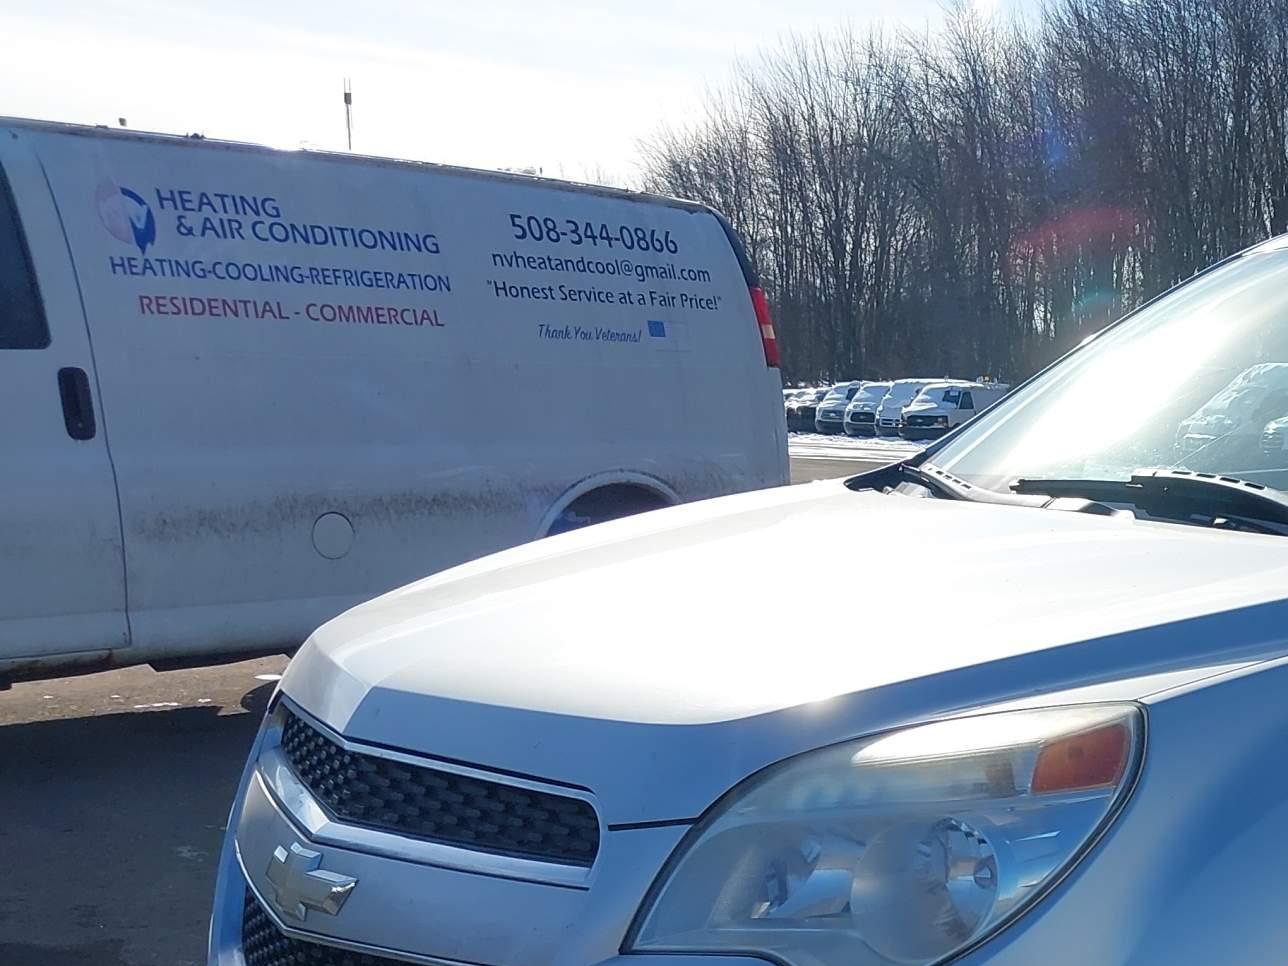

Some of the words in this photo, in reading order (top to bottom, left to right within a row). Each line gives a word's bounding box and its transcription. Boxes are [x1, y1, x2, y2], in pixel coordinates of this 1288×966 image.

[155, 188, 281, 218] HEATING
[176, 215, 196, 237] &
[201, 217, 243, 240] AIR
[251, 220, 441, 254] CONDITIONING
[510, 213, 678, 254] 508-344-0866
[109, 255, 452, 292] HEATING-COOLING-REFRIGERATION
[492, 251, 711, 283] nvheatandcool@gmail.com
[487, 279, 554, 300] "Honest
[559, 284, 614, 304] Service
[618, 290, 634, 305] at
[638, 294, 647, 306] a
[650, 291, 677, 308] Fair
[138, 295, 290, 320] RESIDENTIAL
[306, 303, 445, 327] COMMERCIAL
[538, 323, 572, 340] Thank
